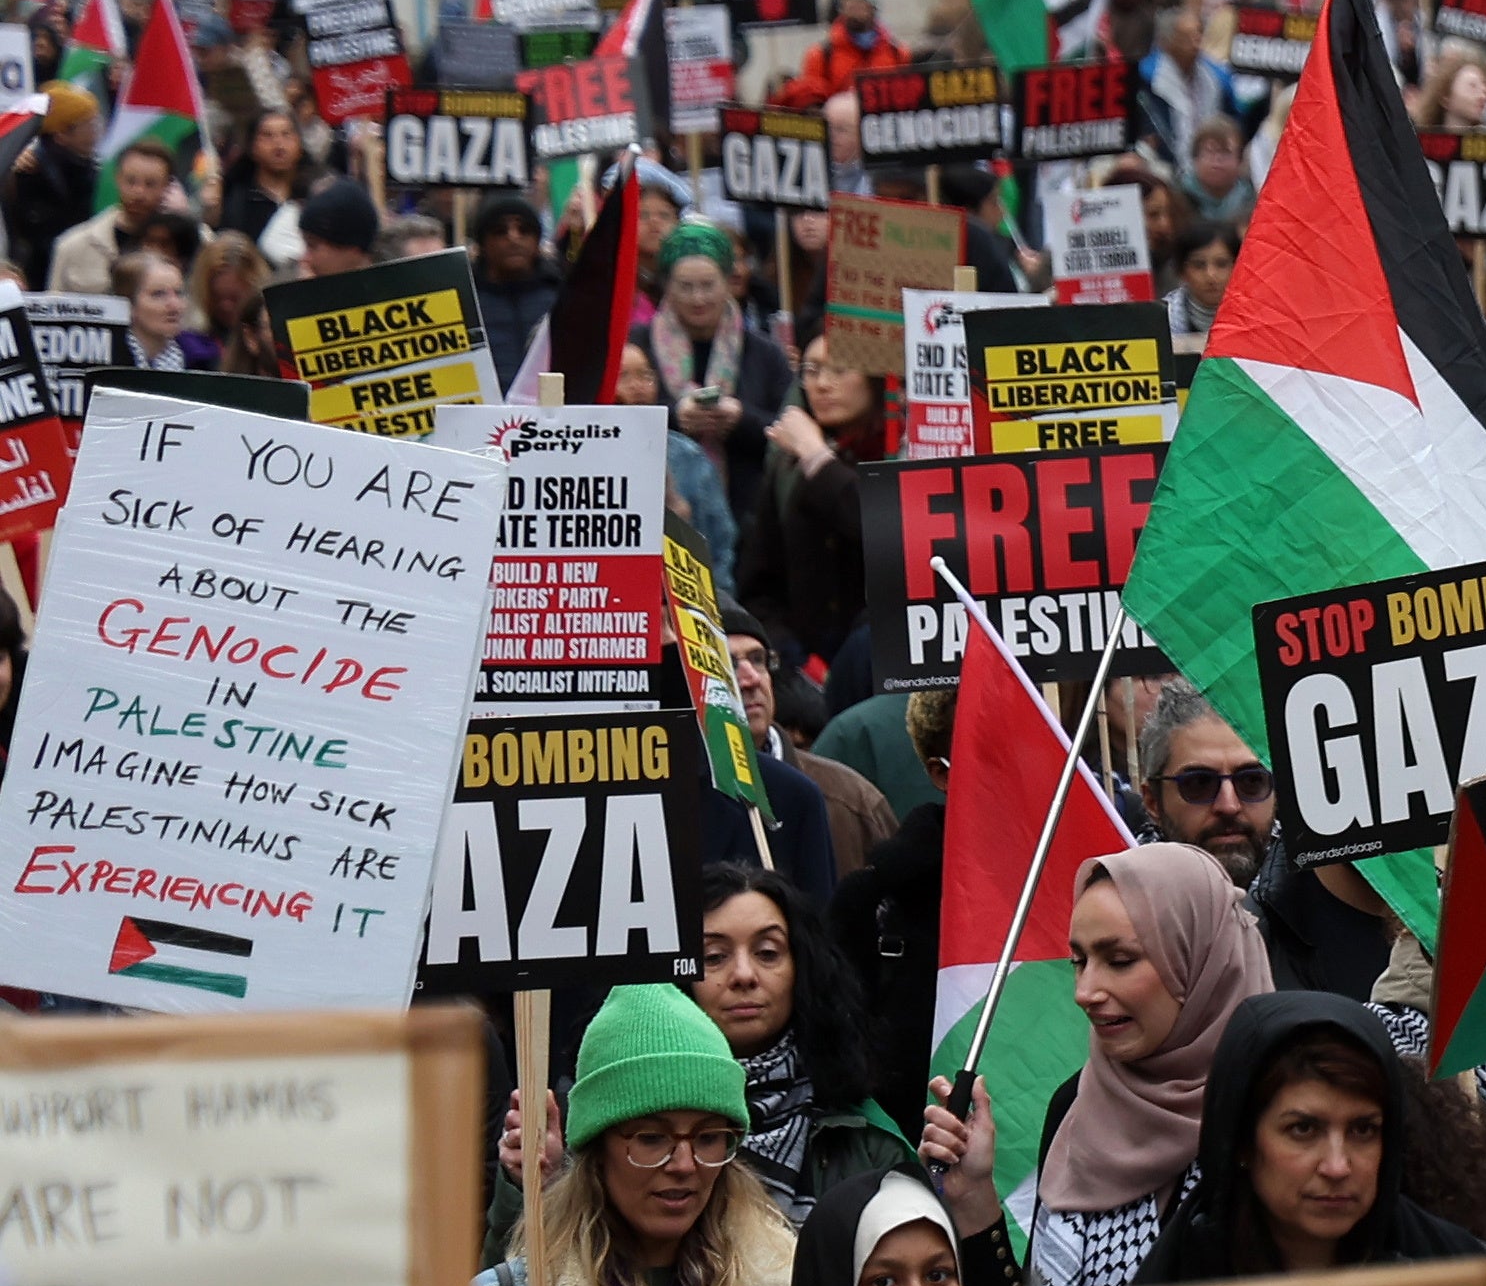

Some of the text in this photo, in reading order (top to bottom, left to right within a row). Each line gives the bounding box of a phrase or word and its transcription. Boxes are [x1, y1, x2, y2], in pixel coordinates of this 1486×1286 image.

[1025, 63, 1129, 120] FREE
[388, 116, 528, 185] GAZA
[861, 102, 1000, 154] GENOCIDE
[1021, 120, 1127, 159] PALESTINE
[723, 132, 828, 207] GAZA
[317, 299, 433, 343] BLACK
[300, 330, 467, 378] LIBERATION:
[1016, 344, 1130, 375] BLACK
[352, 372, 437, 412] FREE
[991, 379, 1159, 409] LIBERATION:
[519, 421, 622, 439] Socialist
[140, 422, 474, 522] IF YOU ARE
[535, 476, 628, 510] ISRAELI
[102, 489, 466, 581] SICK HEARING
[547, 514, 641, 547] TERROR
[899, 453, 1155, 600] FREE
[562, 562, 598, 583] NEW
[158, 563, 416, 634] ABOUT THE
[558, 588, 608, 609] PARTY
[544, 612, 648, 634] ALTERNATIVE
[1275, 598, 1375, 667] STOP
[97, 598, 409, 703] GENOCIDE
[531, 637, 647, 660] AND STARMER
[207, 676, 256, 708] IN
[492, 670, 649, 694] SOCIALIST INTIFADA
[84, 686, 349, 768] PALESTINE
[462, 725, 670, 788] BOMBING
[32, 732, 397, 830] IMAGINE HOW SICK
[27, 790, 400, 881] PALESTINIANS ARE
[333, 903, 386, 938] IT
[674, 958, 697, 976] FOA
[165, 1175, 331, 1242] NOT
